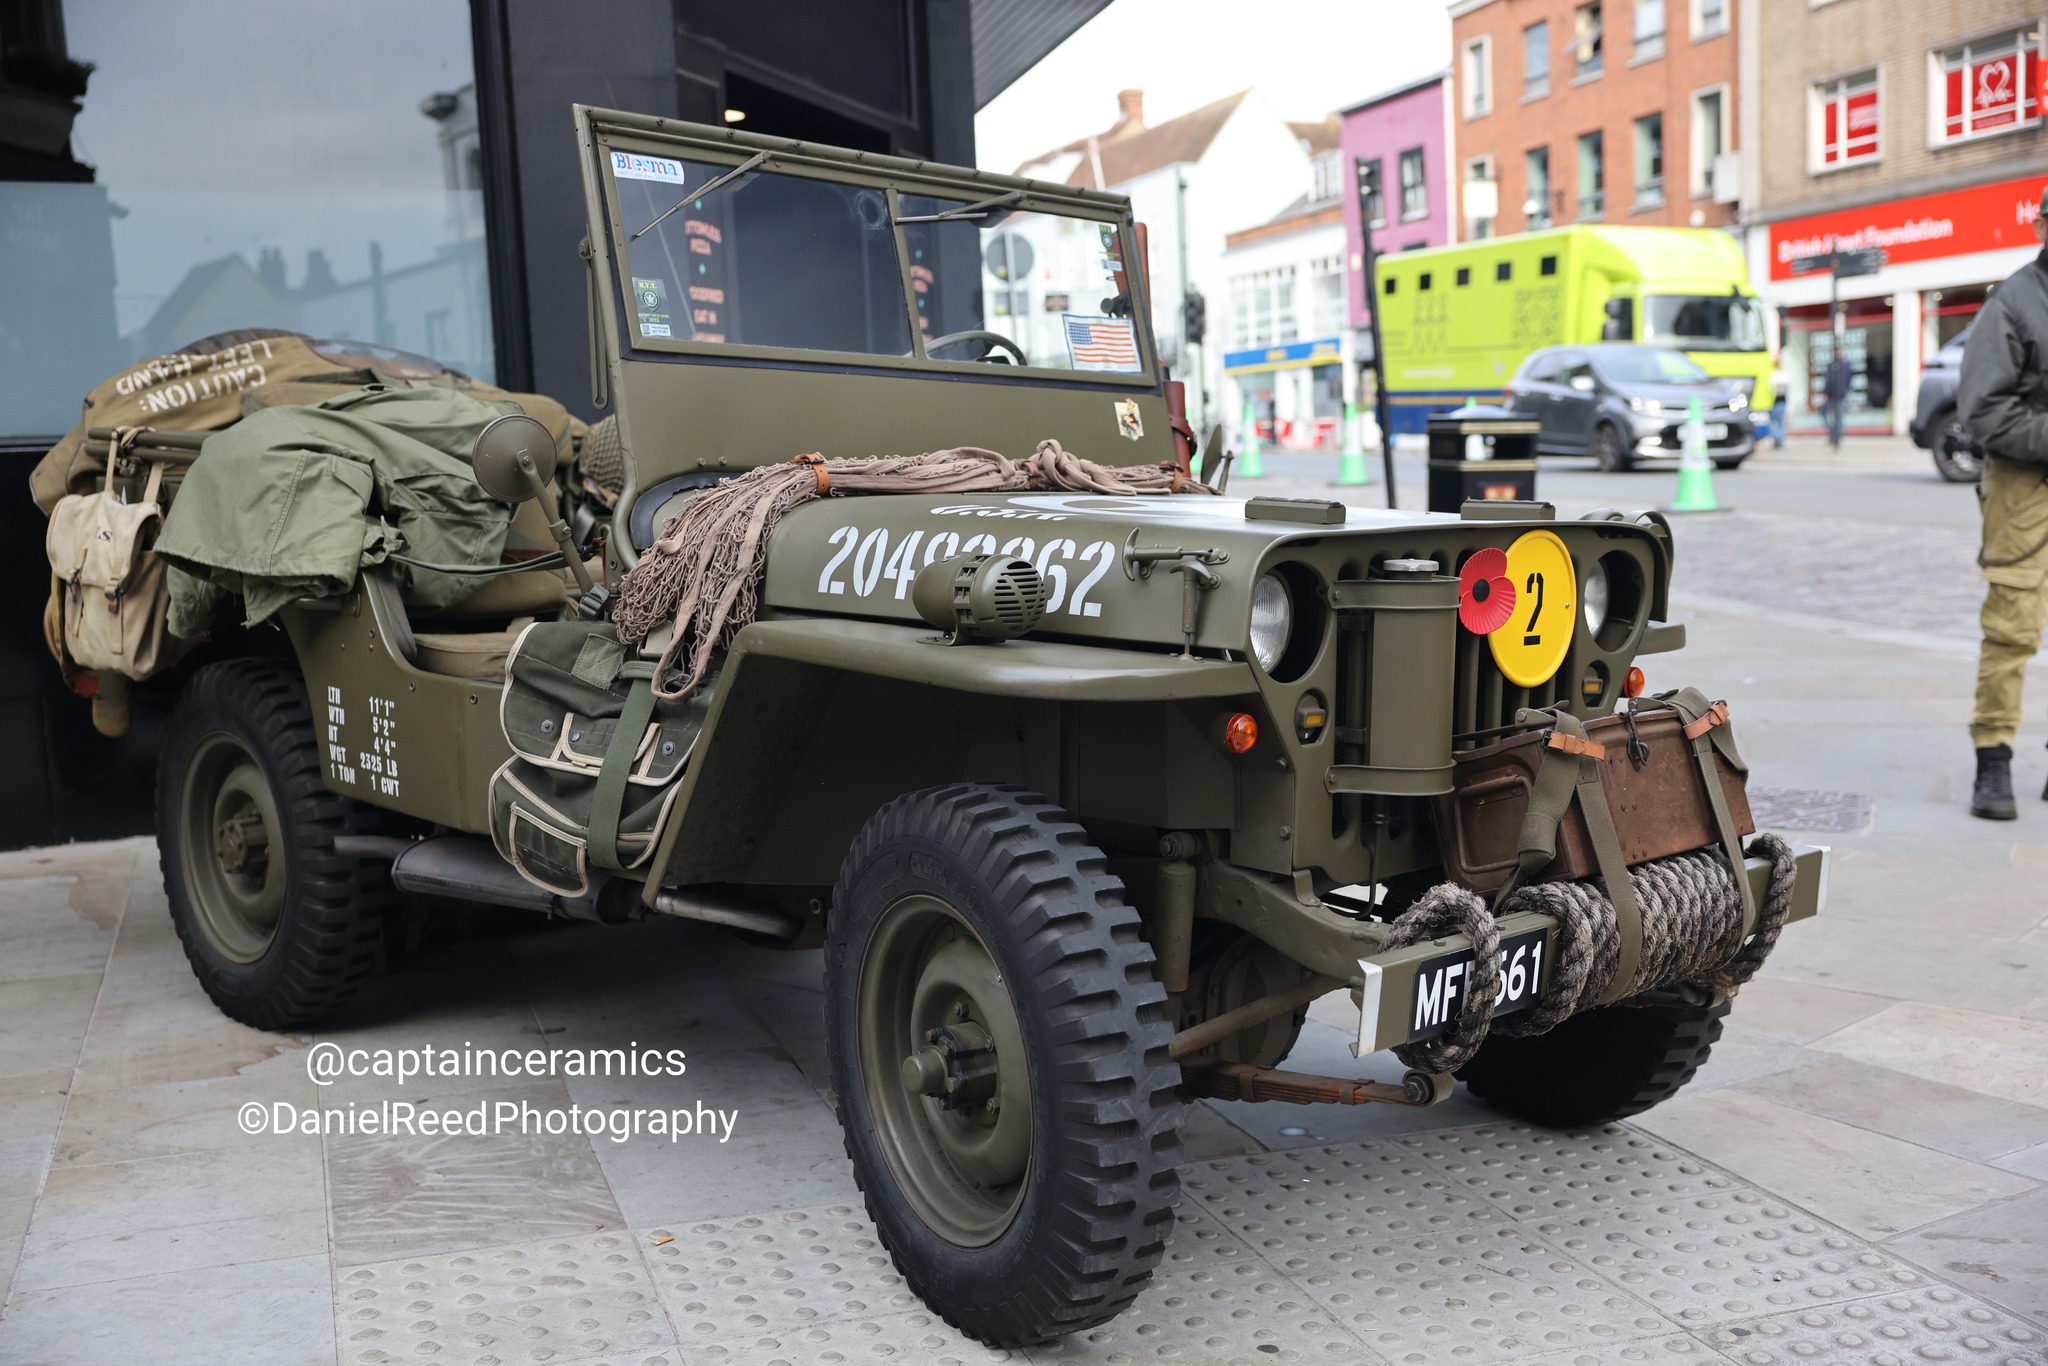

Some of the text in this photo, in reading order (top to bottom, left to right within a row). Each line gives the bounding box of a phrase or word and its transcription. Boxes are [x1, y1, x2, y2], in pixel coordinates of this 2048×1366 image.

[615, 153, 678, 176] Blesma
[1864, 217, 1953, 247] Foundation
[139, 364, 267, 413] CAUTION:
[1523, 572, 1544, 646] 2
[328, 685, 395, 717] LTH 11'1"
[328, 704, 396, 737] WTH 5'2"
[328, 724, 397, 757] HT 4'4"
[329, 743, 398, 778] WGT 2325 LB
[330, 762, 399, 797] 1 TON 1 CWT
